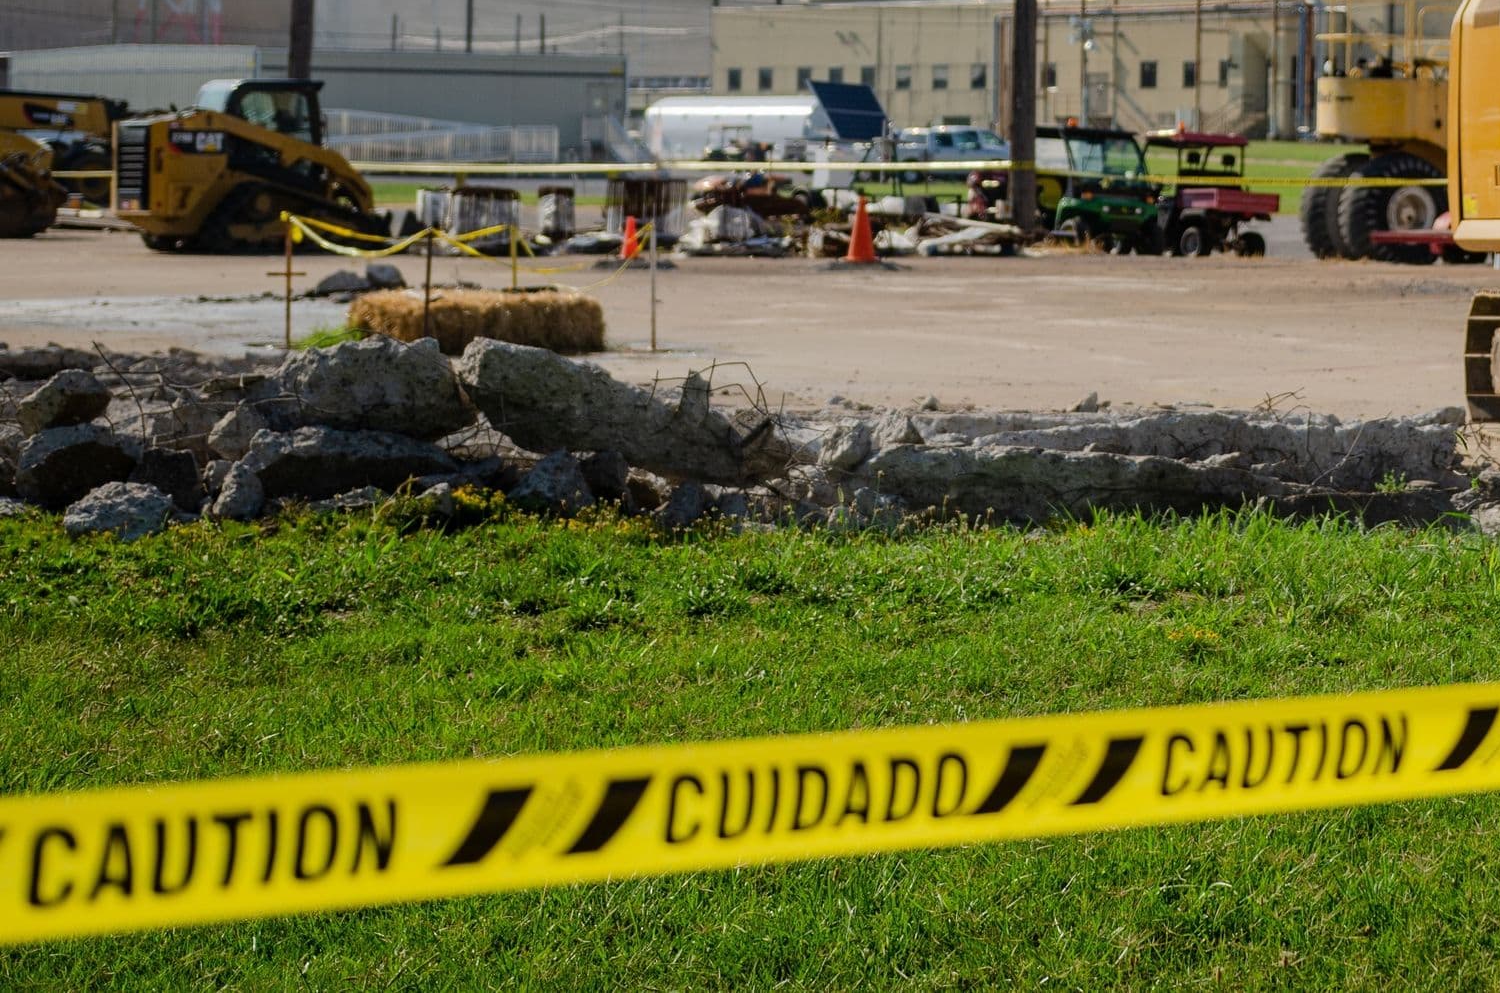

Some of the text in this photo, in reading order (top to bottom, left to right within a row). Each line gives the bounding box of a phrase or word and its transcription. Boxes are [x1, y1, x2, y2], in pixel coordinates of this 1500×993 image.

[196, 132, 224, 152] CAT
[26, 798, 398, 909] CAUTION
[664, 751, 969, 845] CUIDADO
[1161, 716, 1408, 796] CAUTION
